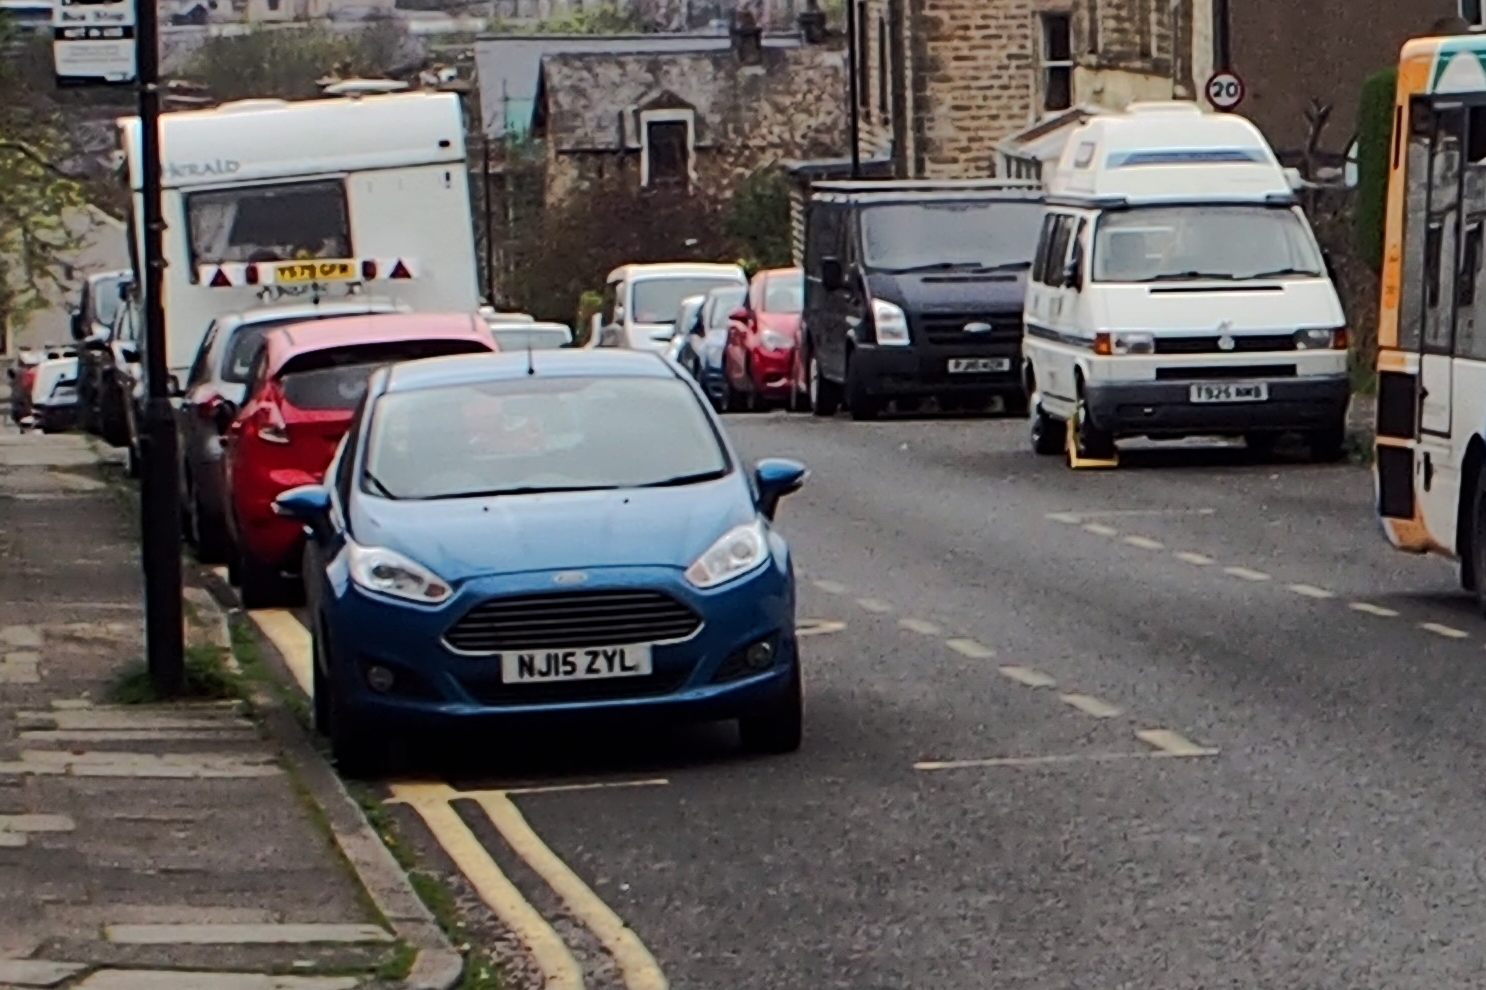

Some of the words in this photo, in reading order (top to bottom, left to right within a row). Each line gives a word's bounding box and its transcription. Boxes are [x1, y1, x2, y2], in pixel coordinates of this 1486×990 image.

[1211, 81, 1239, 98] 20
[517, 651, 577, 679] NJ15
[584, 647, 640, 675] ZYL
